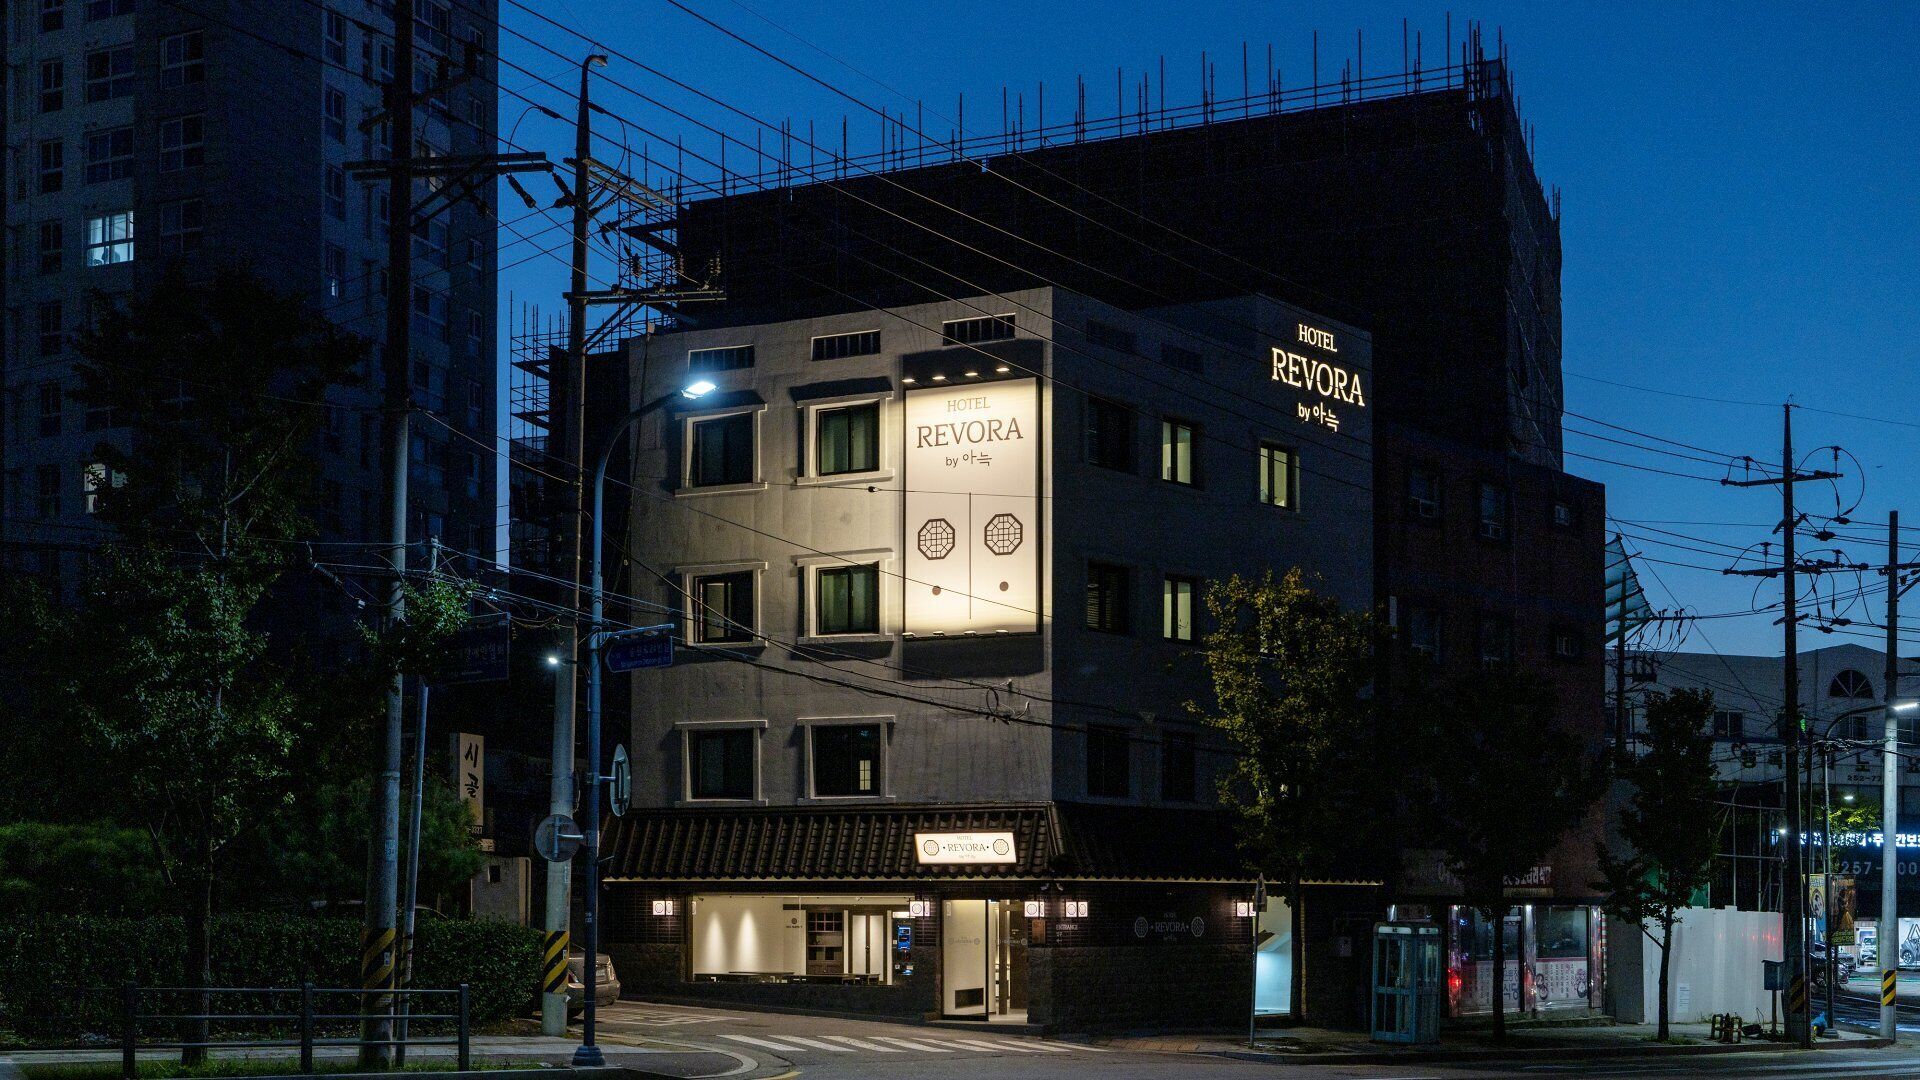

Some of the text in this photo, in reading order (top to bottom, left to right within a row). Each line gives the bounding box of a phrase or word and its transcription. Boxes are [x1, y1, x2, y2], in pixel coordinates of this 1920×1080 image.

[1297, 323, 1338, 352] HOTEL
[1271, 347, 1366, 407] REVORA
[946, 396, 991, 413] HOTEL
[1298, 402, 1340, 432] by 아늑
[916, 417, 1024, 449] REVORA
[945, 449, 993, 468] by 아늑
[947, 843, 986, 852] REVORA
[1155, 922, 1186, 933] REVORA
